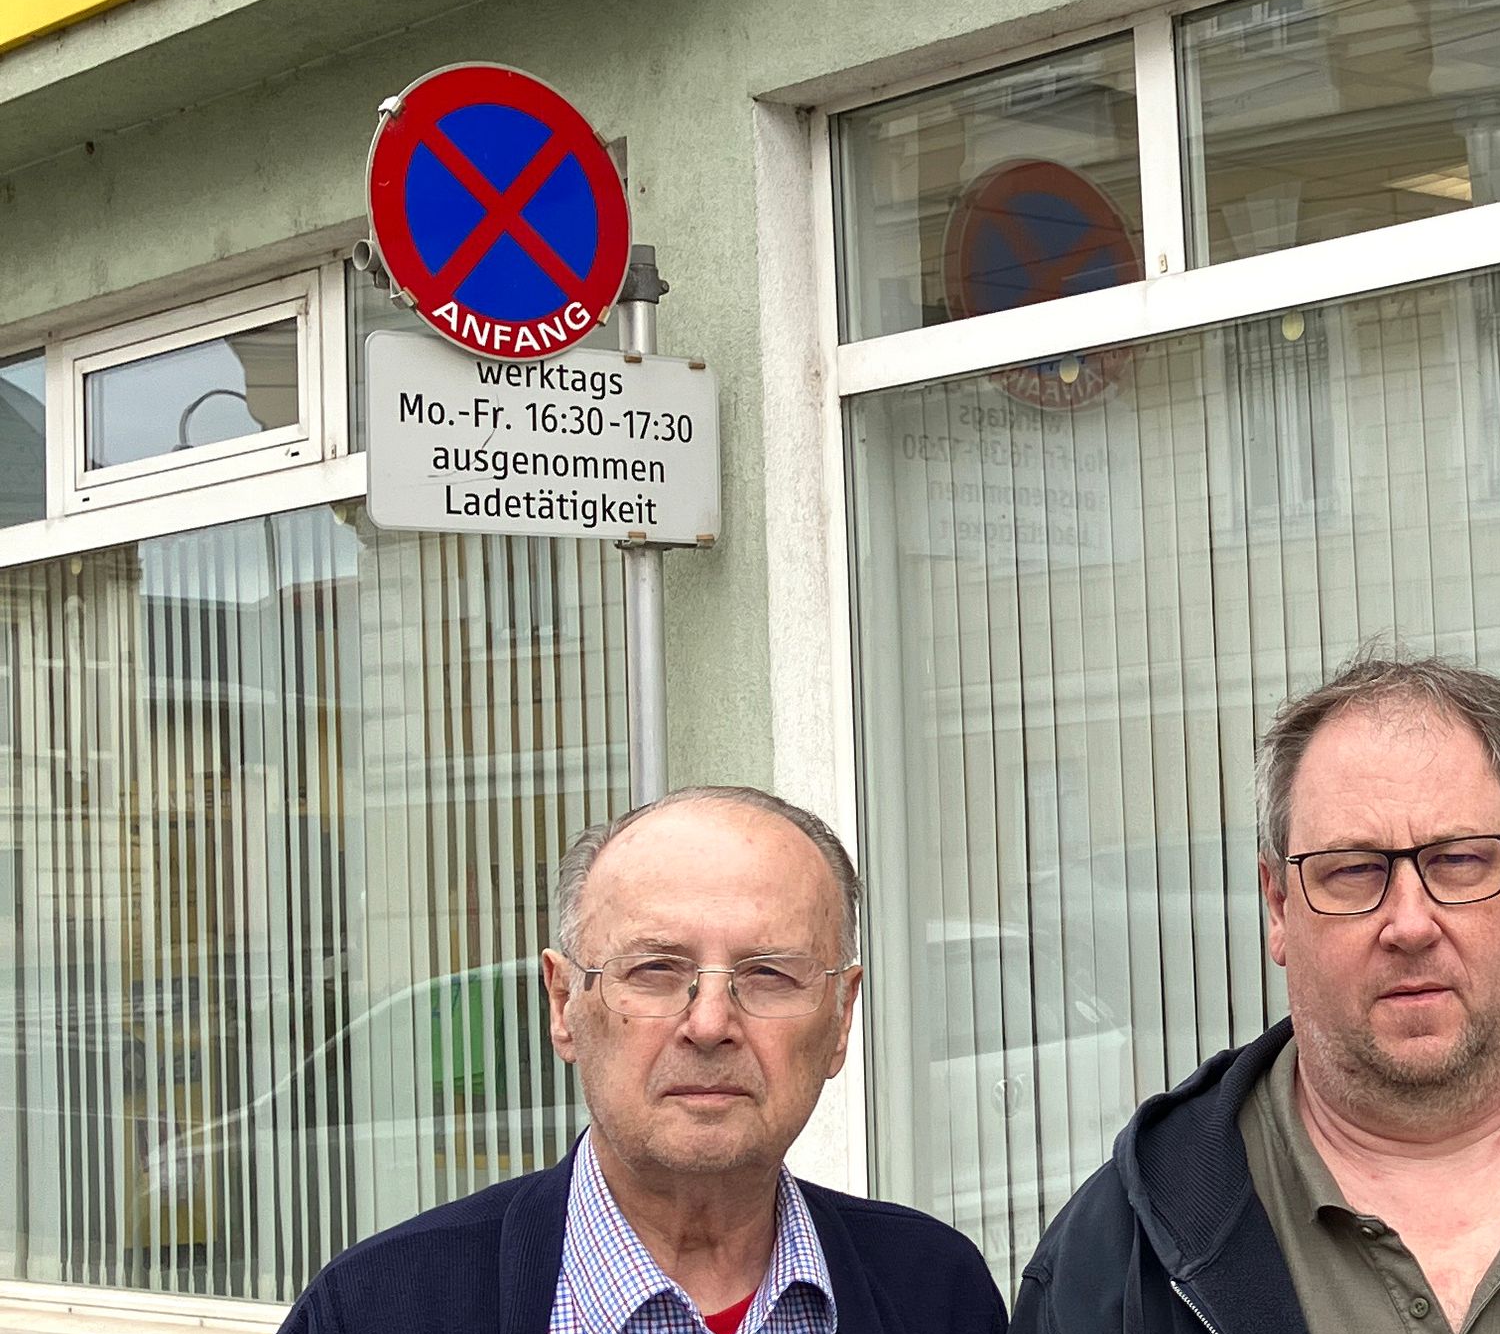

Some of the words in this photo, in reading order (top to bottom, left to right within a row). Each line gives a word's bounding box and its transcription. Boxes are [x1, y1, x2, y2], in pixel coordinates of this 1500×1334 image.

[432, 301, 591, 353] ANFANG
[477, 360, 623, 400] werktags
[400, 392, 512, 430] Mo.-Fr.
[432, 446, 665, 483] ausgenommen
[445, 485, 657, 528] Ladetätigkeit
